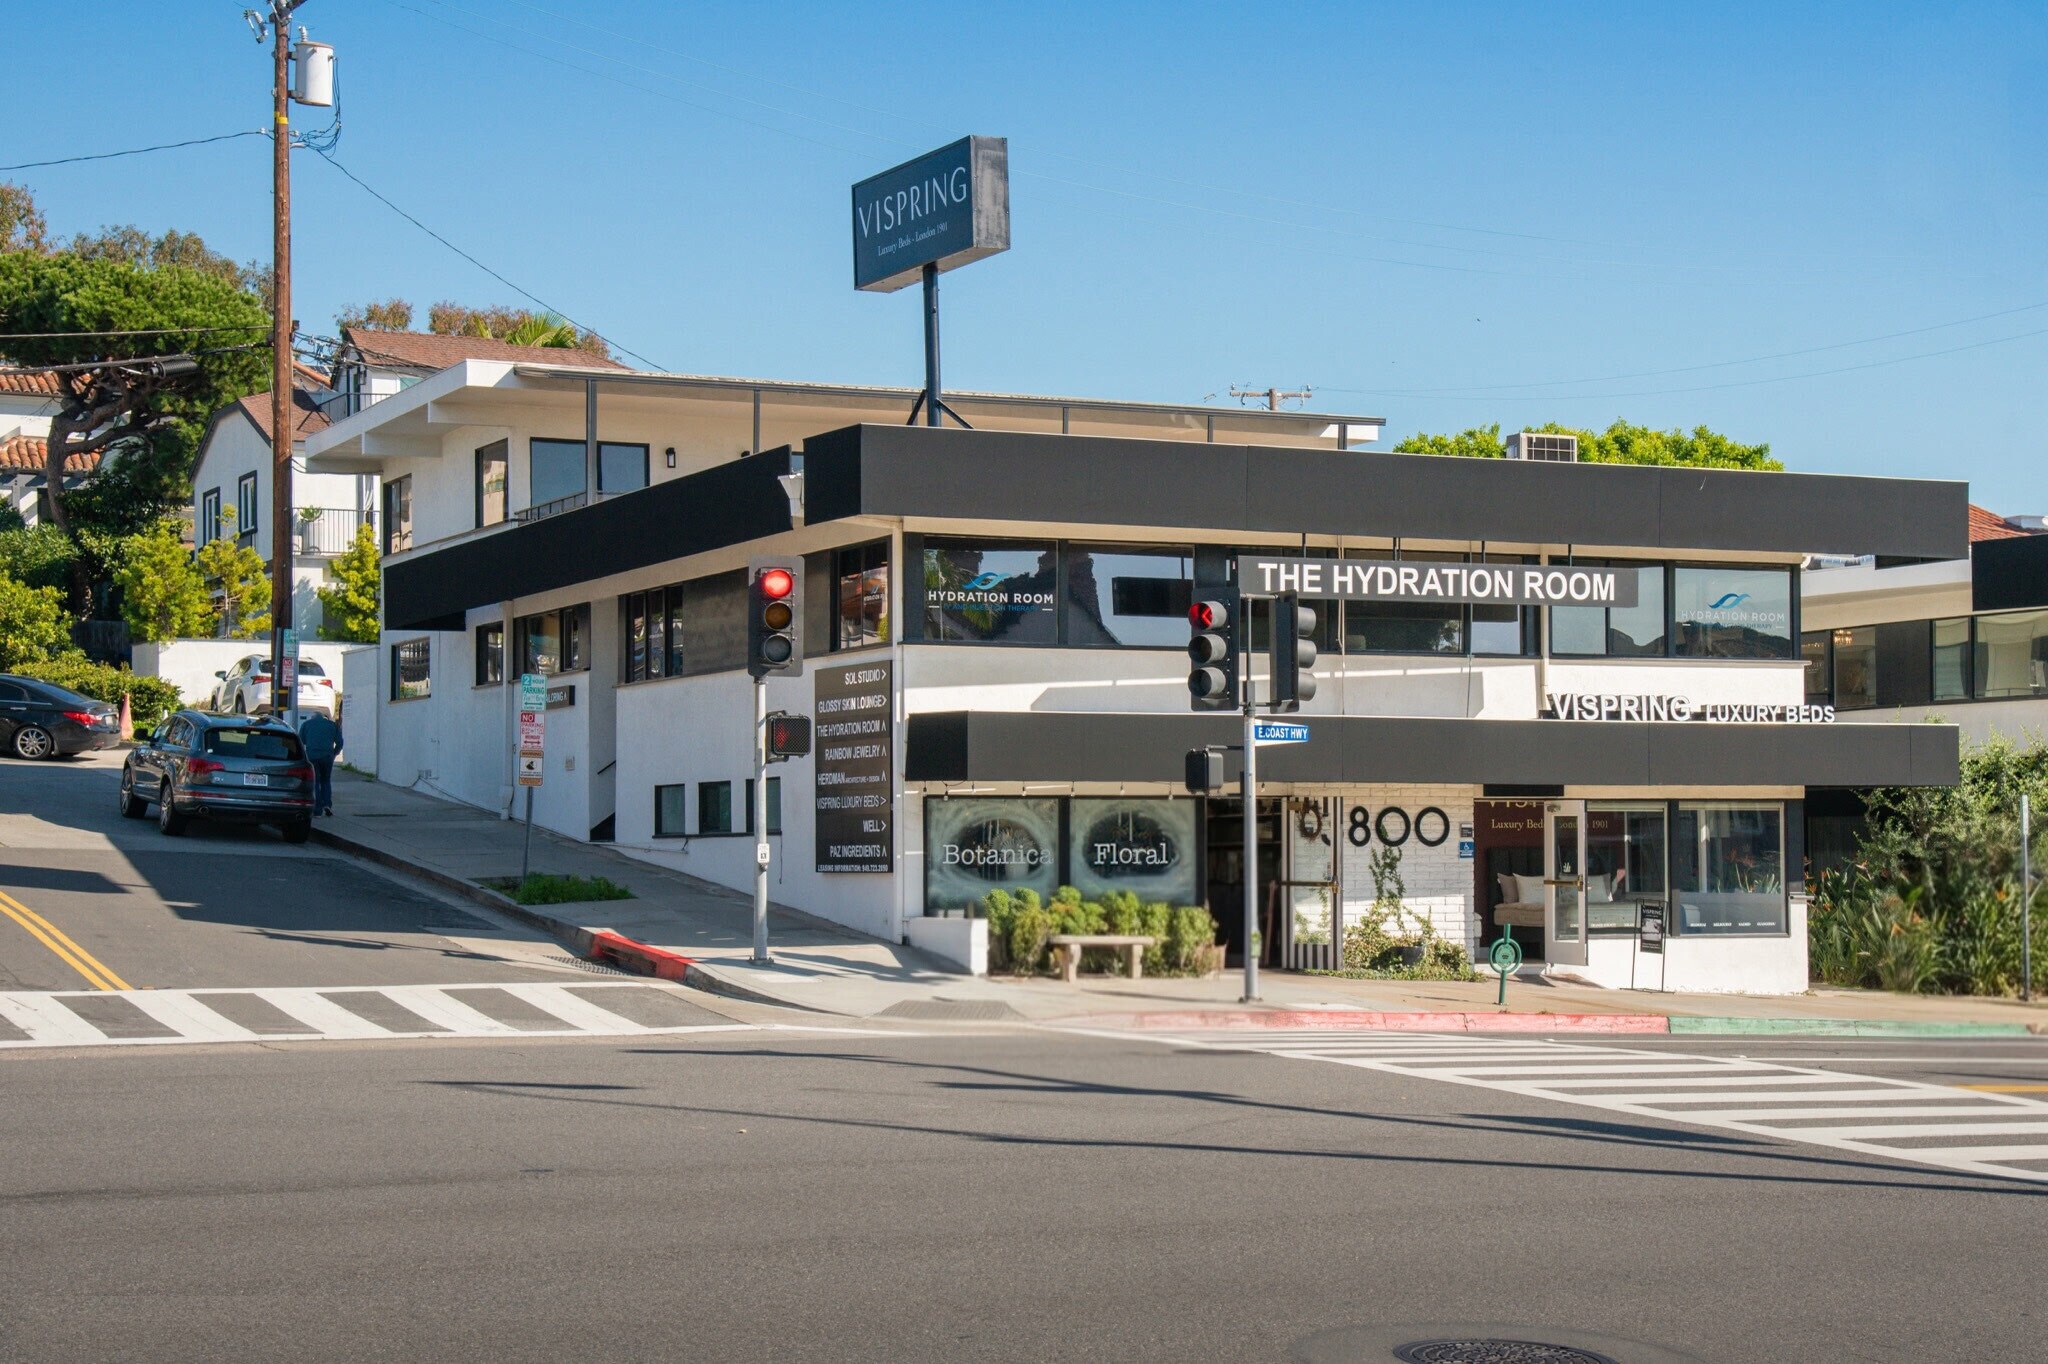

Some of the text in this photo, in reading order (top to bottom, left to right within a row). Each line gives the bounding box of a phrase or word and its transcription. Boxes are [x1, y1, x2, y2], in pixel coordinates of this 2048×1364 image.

[858, 166, 967, 239] VISPRING
[877, 221, 948, 257] Luxury Beds London 1901
[1258, 562, 1616, 601] THE HYDRATION ROOM
[928, 590, 1054, 605] HYDRATION ROOM
[1681, 610, 1785, 623] HYDRATION ROOM
[844, 668, 880, 686] SOL STUDIO
[818, 694, 882, 714] GLOSSY SKIN LOUNGE
[1548, 693, 1836, 723] VISPRING LUXURY BEDS
[522, 714, 534, 722] NO
[816, 719, 881, 737] THE HYDRATION ROOM
[1290, 728, 1308, 740] HWY
[824, 744, 881, 761] RAINBOW JEWELRY
[817, 772, 846, 786] HERDMAN
[816, 794, 880, 810] VISPRING LUXURY BEDS
[862, 819, 881, 833] WELL
[1348, 805, 1450, 847] 800
[1491, 818, 1524, 831] Luxury
[1526, 818, 1544, 829] Bed
[1592, 819, 1609, 829] 1901
[829, 844, 881, 858] PAZ INGREDIENTS
[942, 842, 1169, 866] Botanica Floral
